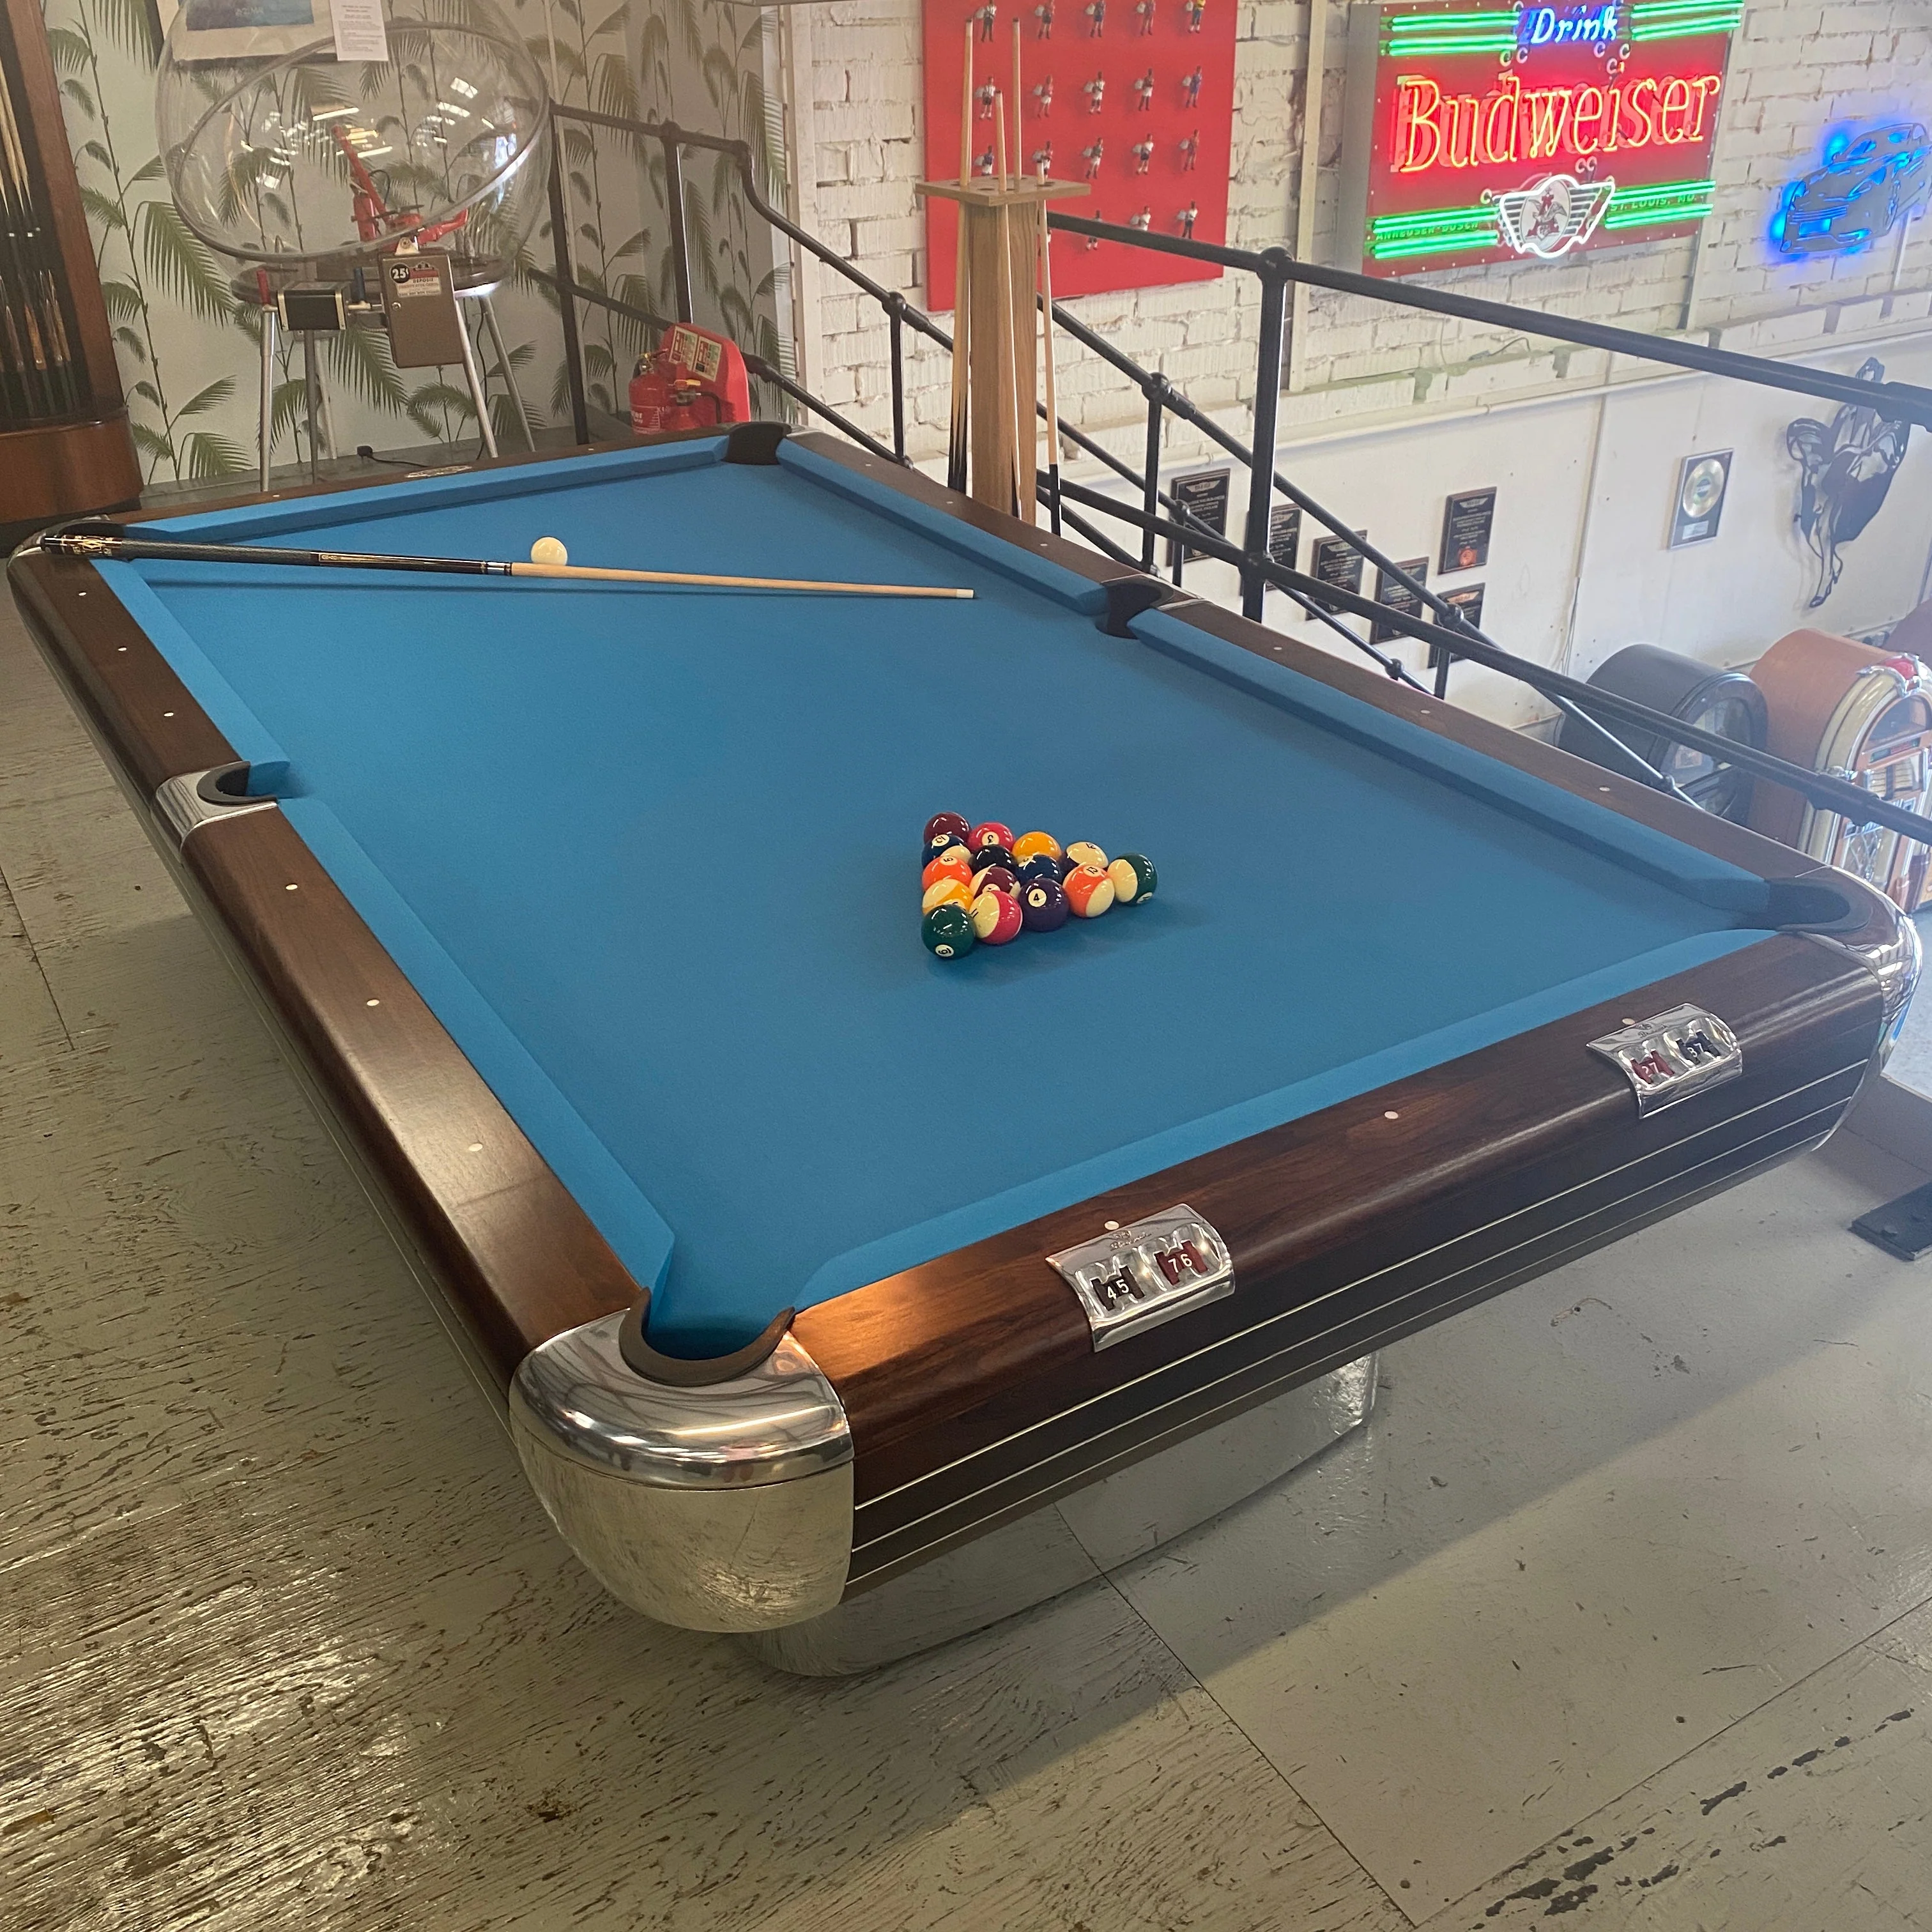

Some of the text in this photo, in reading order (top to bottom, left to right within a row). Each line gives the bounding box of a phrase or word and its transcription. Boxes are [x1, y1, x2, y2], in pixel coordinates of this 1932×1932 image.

[1526, 5, 1618, 44] Drink
[1392, 73, 1720, 172] Budweiser
[986, 834, 993, 844] 3
[1641, 1061, 1659, 1078] 27
[1167, 1253, 1193, 1273] 76
[1107, 1278, 1130, 1300] 45
